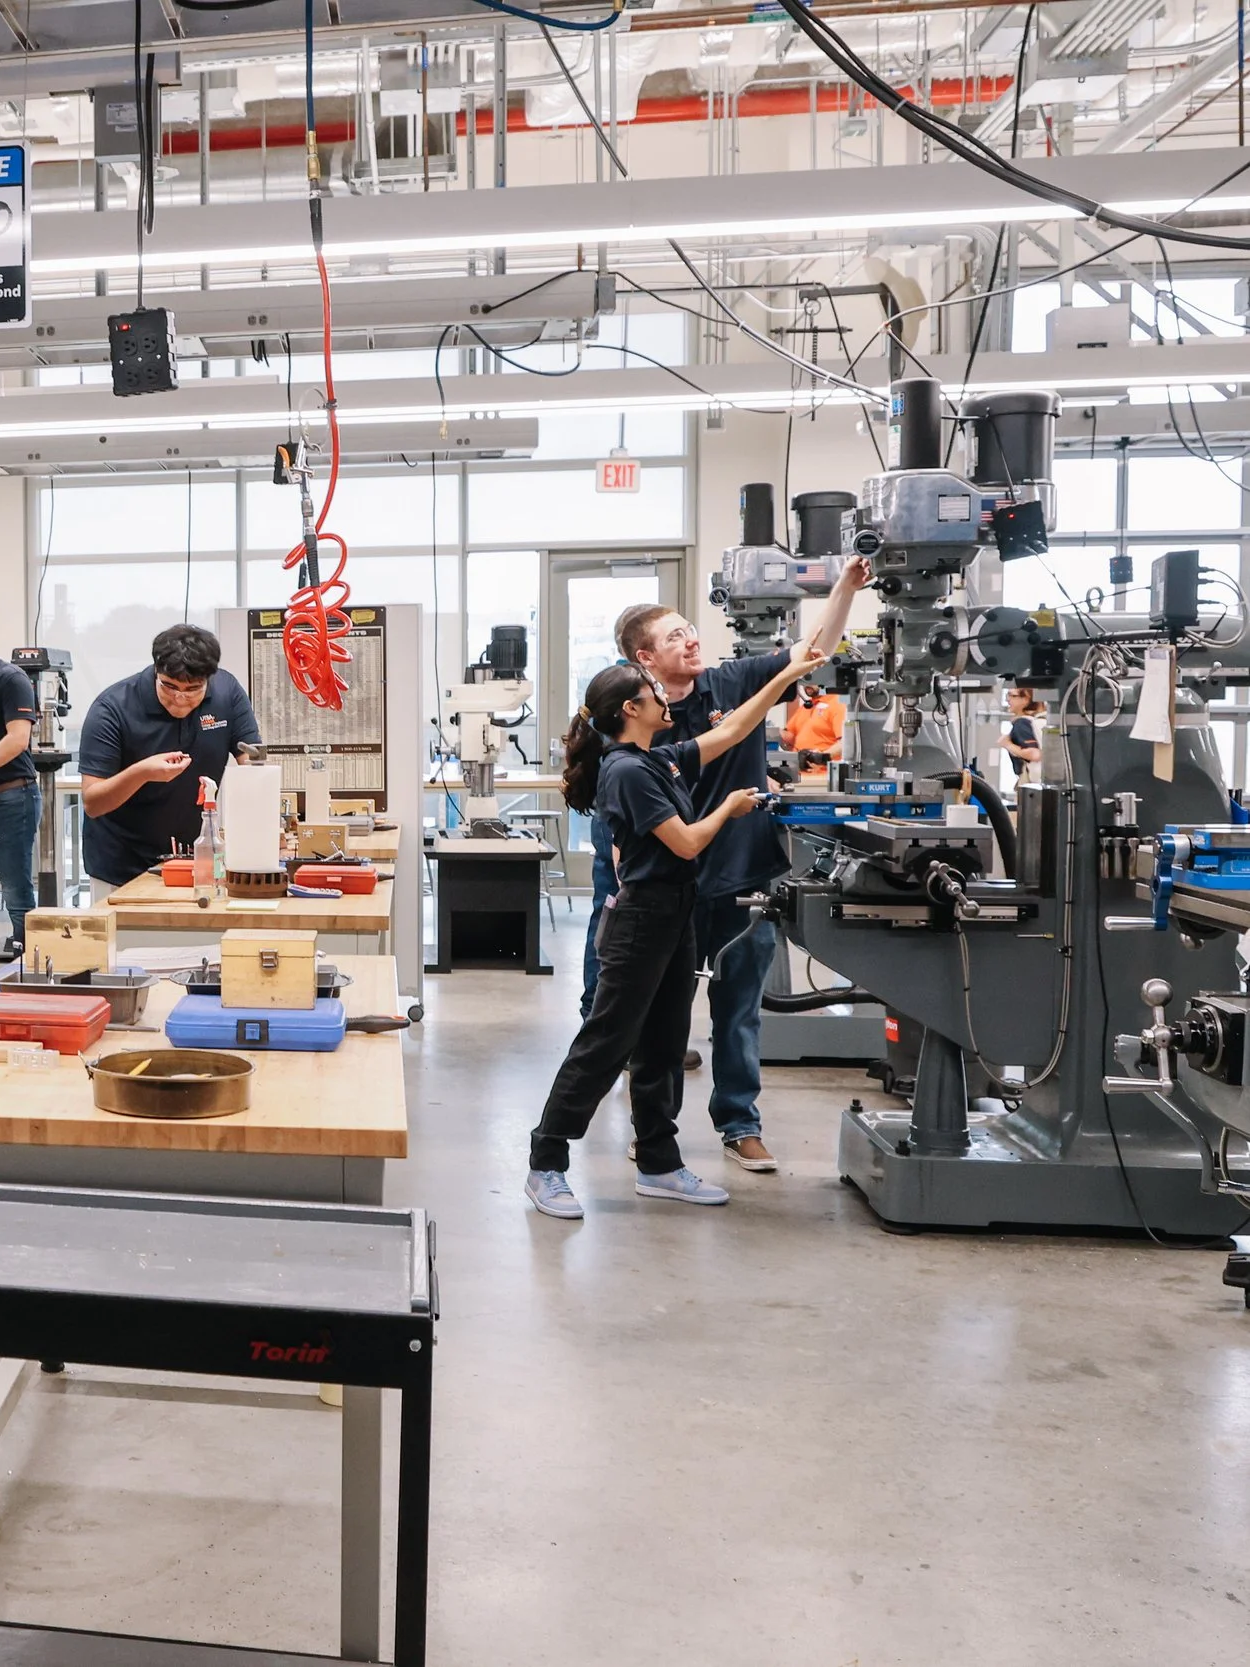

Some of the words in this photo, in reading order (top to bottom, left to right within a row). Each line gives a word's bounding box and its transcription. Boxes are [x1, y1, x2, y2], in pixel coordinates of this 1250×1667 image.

[603, 463, 636, 489] EXIT
[868, 784, 891, 792] KURT
[250, 1341, 328, 1364] Torin
